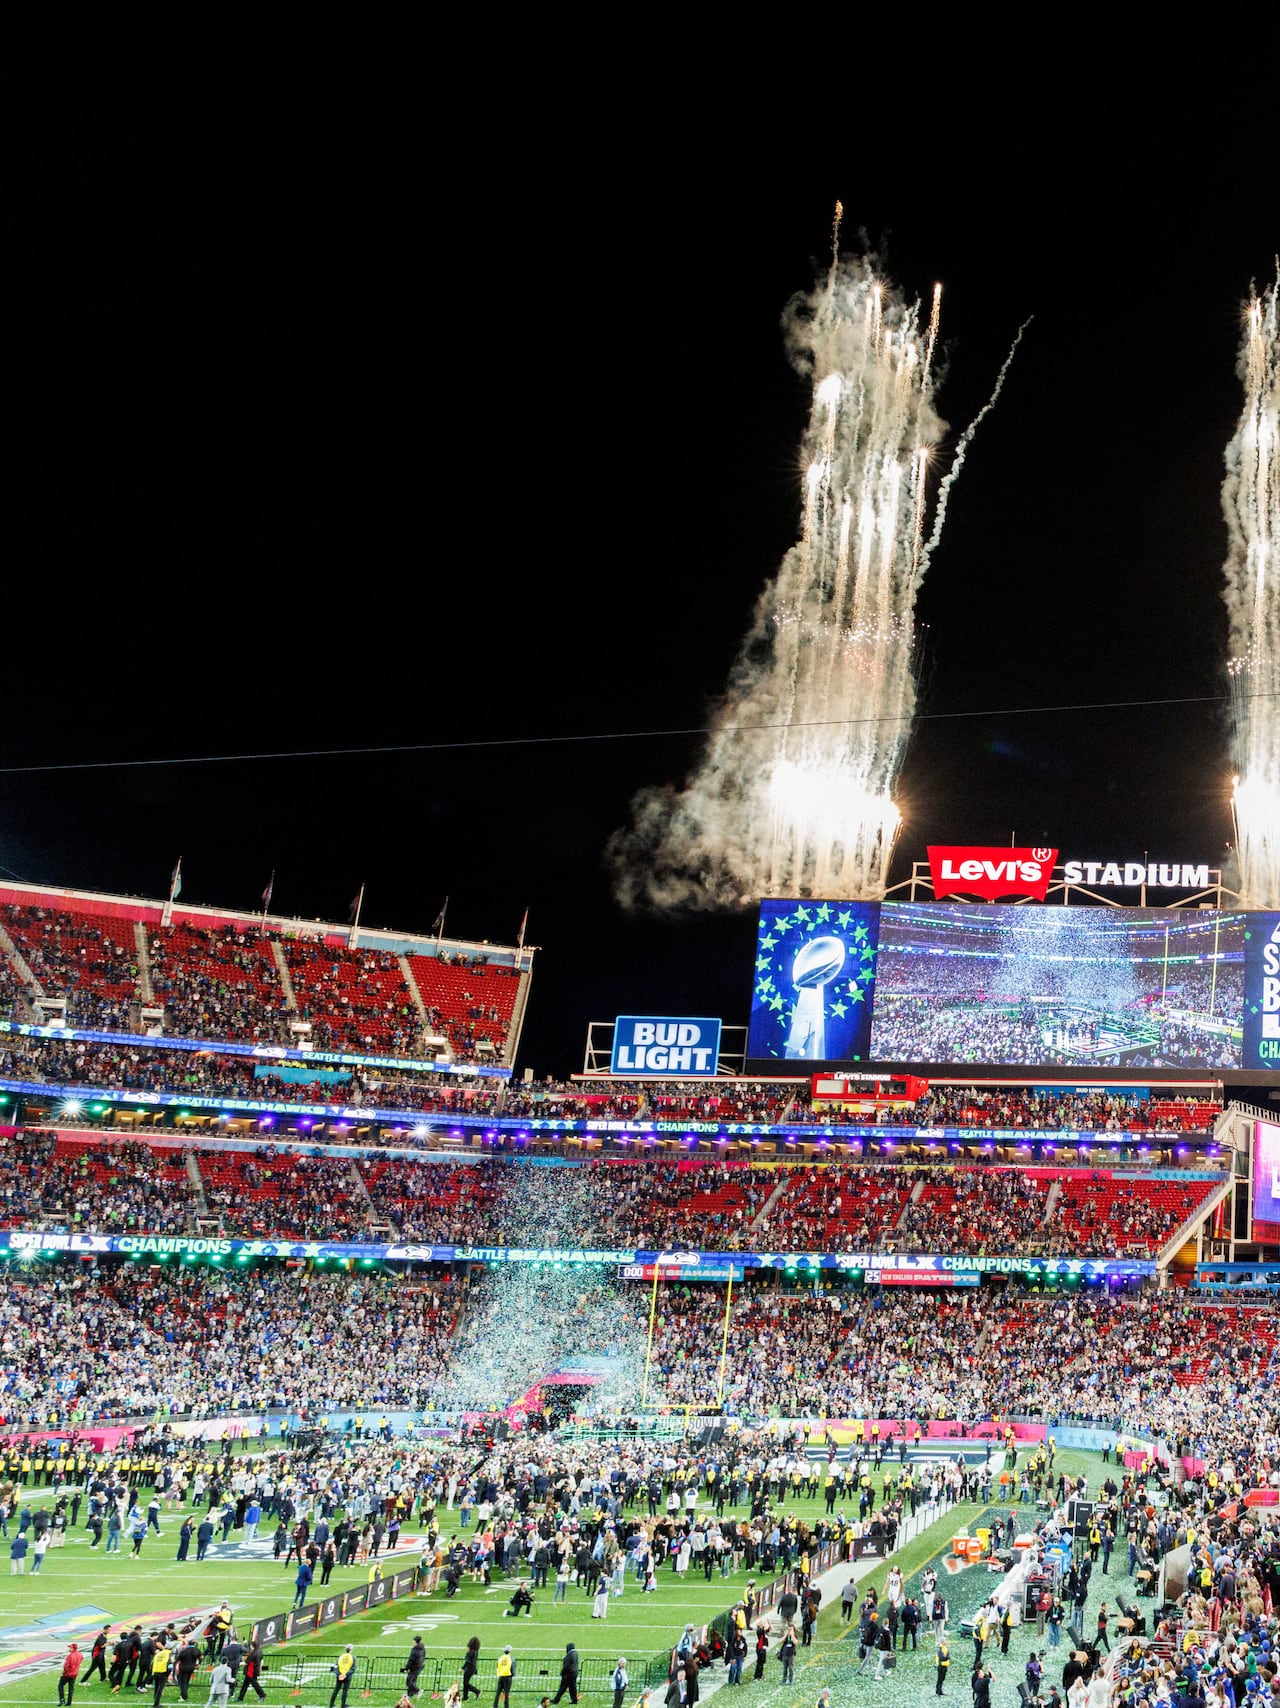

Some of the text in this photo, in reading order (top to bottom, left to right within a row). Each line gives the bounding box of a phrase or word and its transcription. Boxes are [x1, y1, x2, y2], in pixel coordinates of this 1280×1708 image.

[1064, 861, 1209, 887] STADIUM
[633, 1022, 701, 1046] BUD
[302, 1052, 434, 1070] SEATTLE SEAHAWKS
[178, 1096, 326, 1115] SEATTLE SEAHAWKS
[626, 1122, 654, 1131] LX
[656, 1122, 719, 1132] CHAMPIONS
[958, 1129, 1080, 1140] SEATTLE SEAHAWKS
[8, 1234, 232, 1254] SUPER BOWL LX CHAMPIONS
[507, 1249, 635, 1263] SEAHAWKS
[842, 1256, 1031, 1272] SUPER BOWL LX CHAMPIONS
[814, 1290, 824, 1298] 12
[957, 1542, 966, 1551] G
